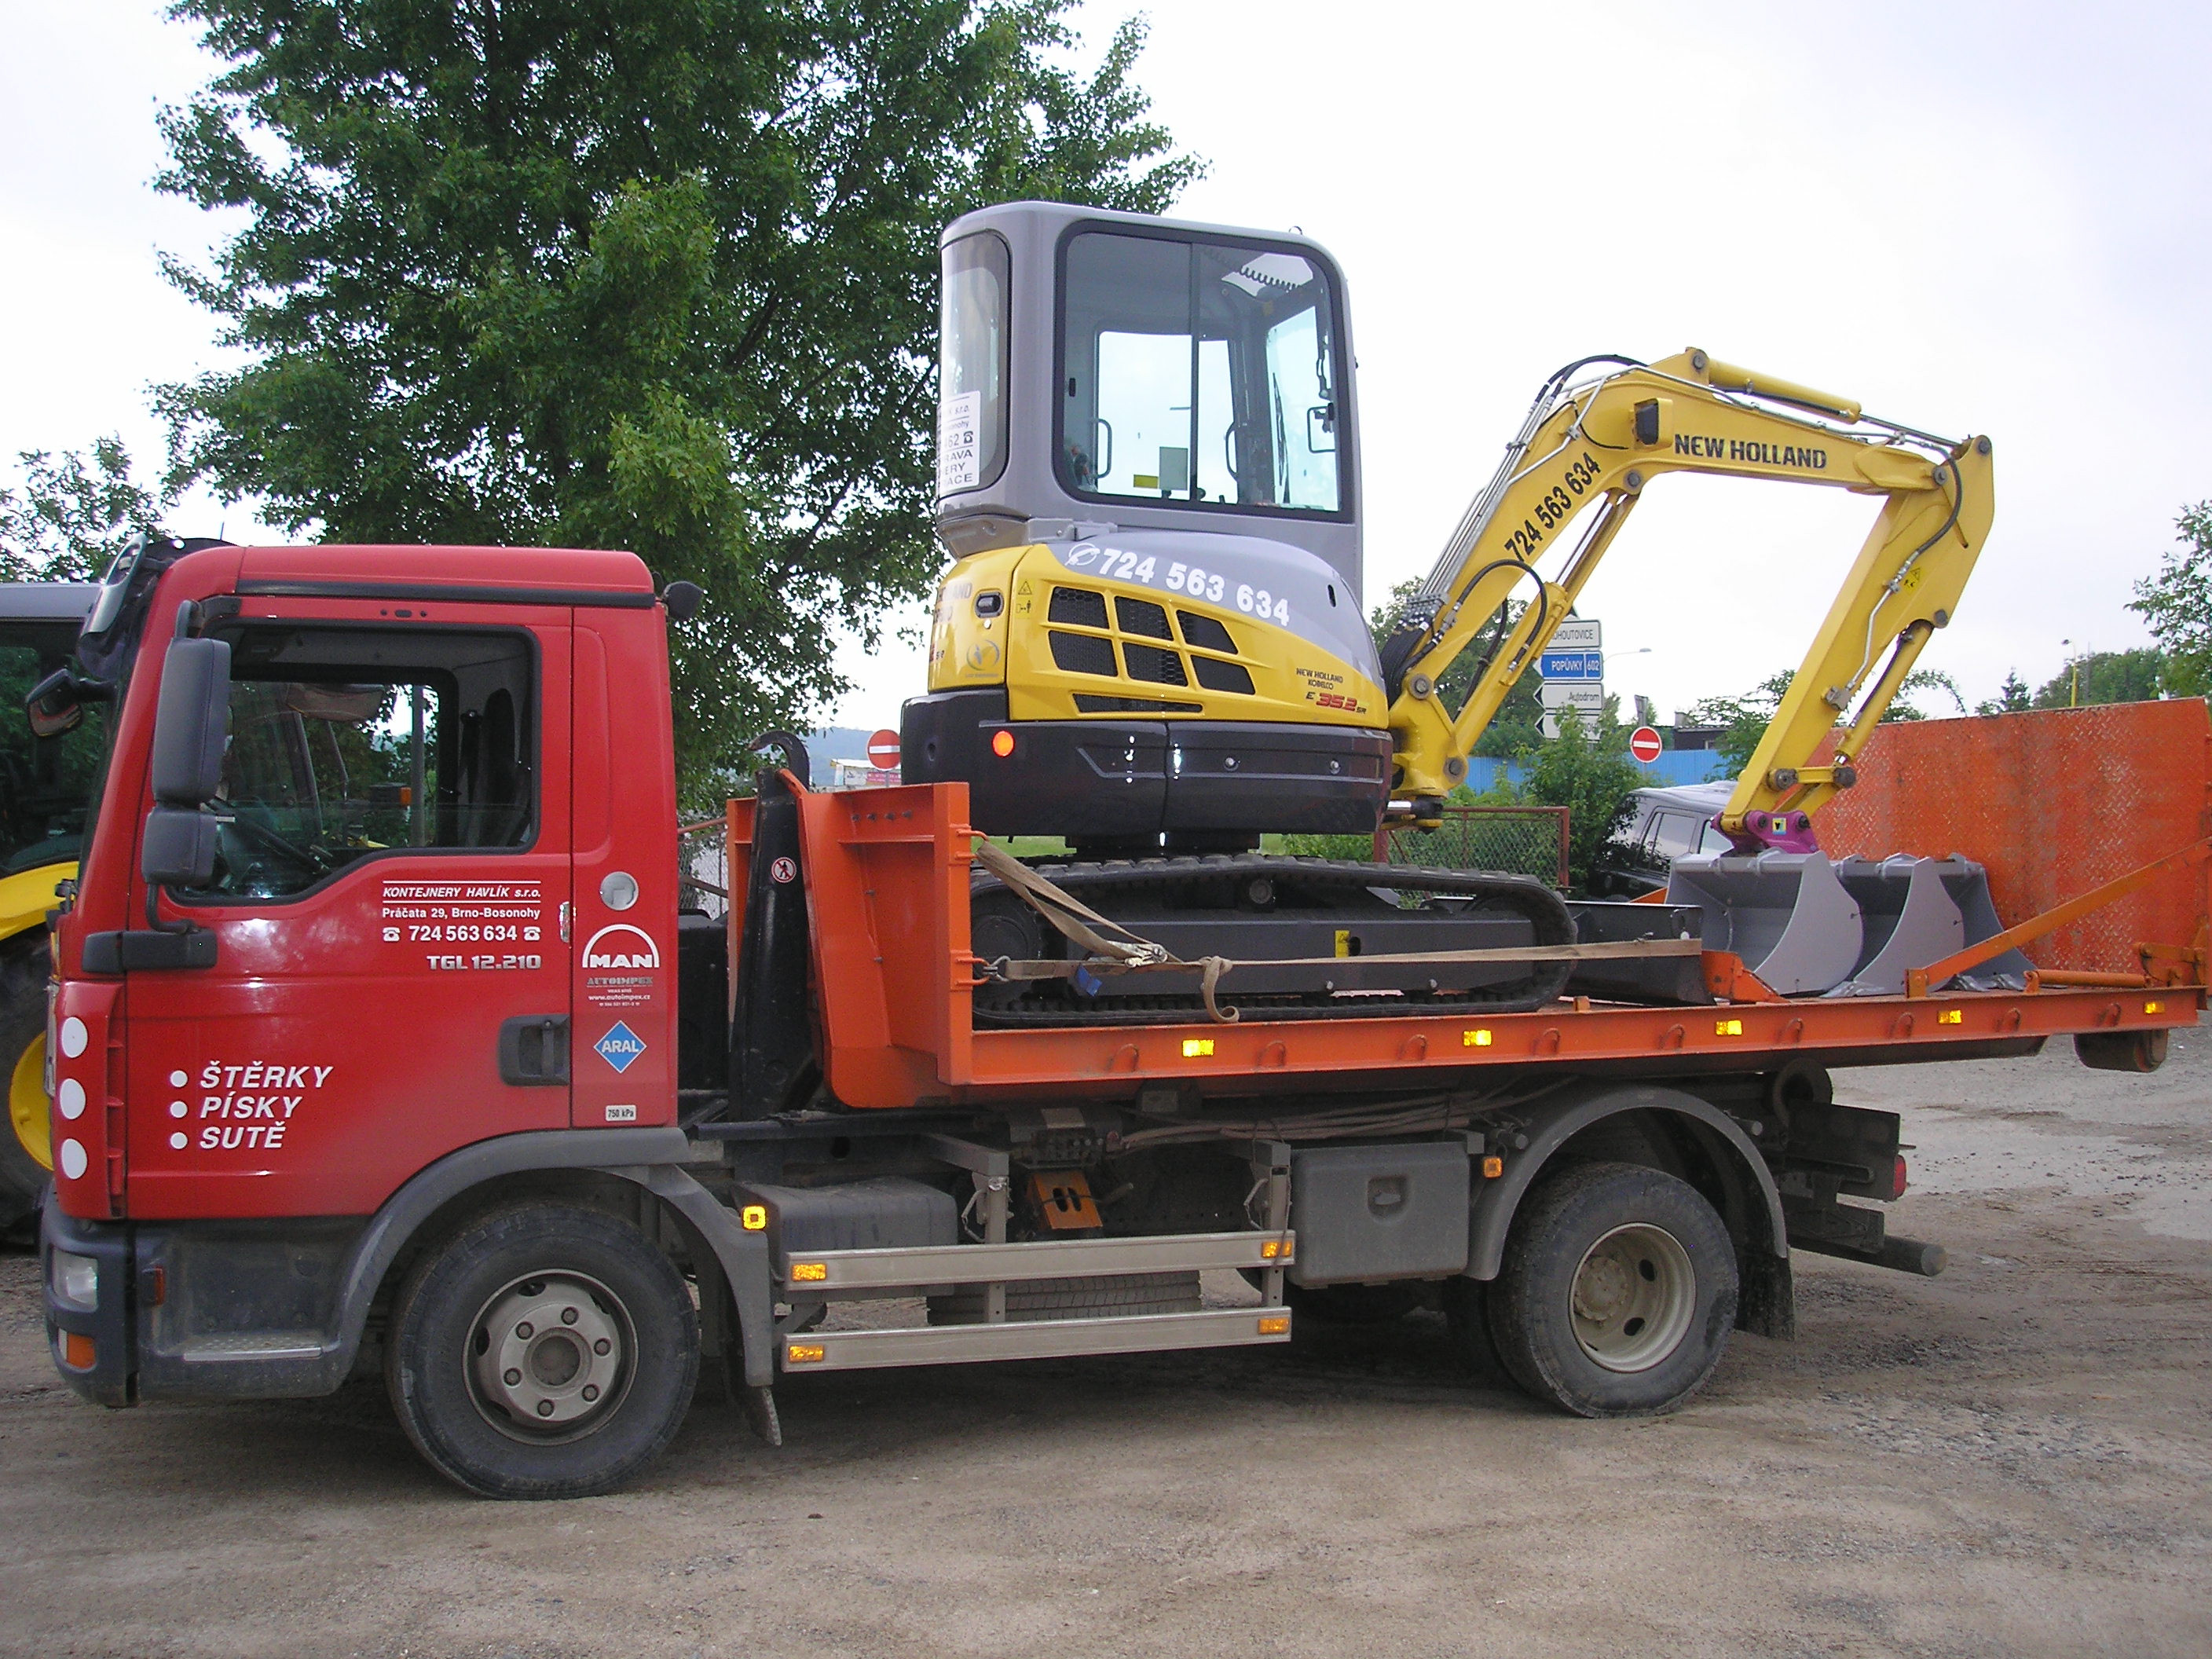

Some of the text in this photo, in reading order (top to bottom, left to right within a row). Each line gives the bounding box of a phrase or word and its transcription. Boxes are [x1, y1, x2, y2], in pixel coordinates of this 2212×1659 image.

[1675, 434, 1826, 469] NEW HOLLAND
[1504, 452, 1601, 562] 724 563 634
[1100, 548, 1290, 627] 724 563 634
[1551, 629, 1593, 640] OHOUTOVICE
[1587, 660, 1599, 671] 602
[1296, 668, 1343, 683] NEW HOLLAND
[1308, 679, 1334, 690] KOBELCO
[1316, 692, 1357, 712] 352
[1569, 691, 1599, 701] Autodrom
[383, 885, 541, 897] KONTEJNERY HAVLÍK s.r.o.
[382, 907, 540, 920] Práčata 29, Brno-Bosonohy
[408, 925, 518, 941] 724 563 634
[426, 955, 541, 969] TGL 12.210
[589, 954, 653, 969] MAN
[601, 1040, 639, 1053] ARAL
[200, 1060, 334, 1089] ŠTĚRKY
[200, 1091, 302, 1119] PÍSKY
[608, 1108, 634, 1118] 750 kPa
[200, 1121, 286, 1149] SUTĚ
